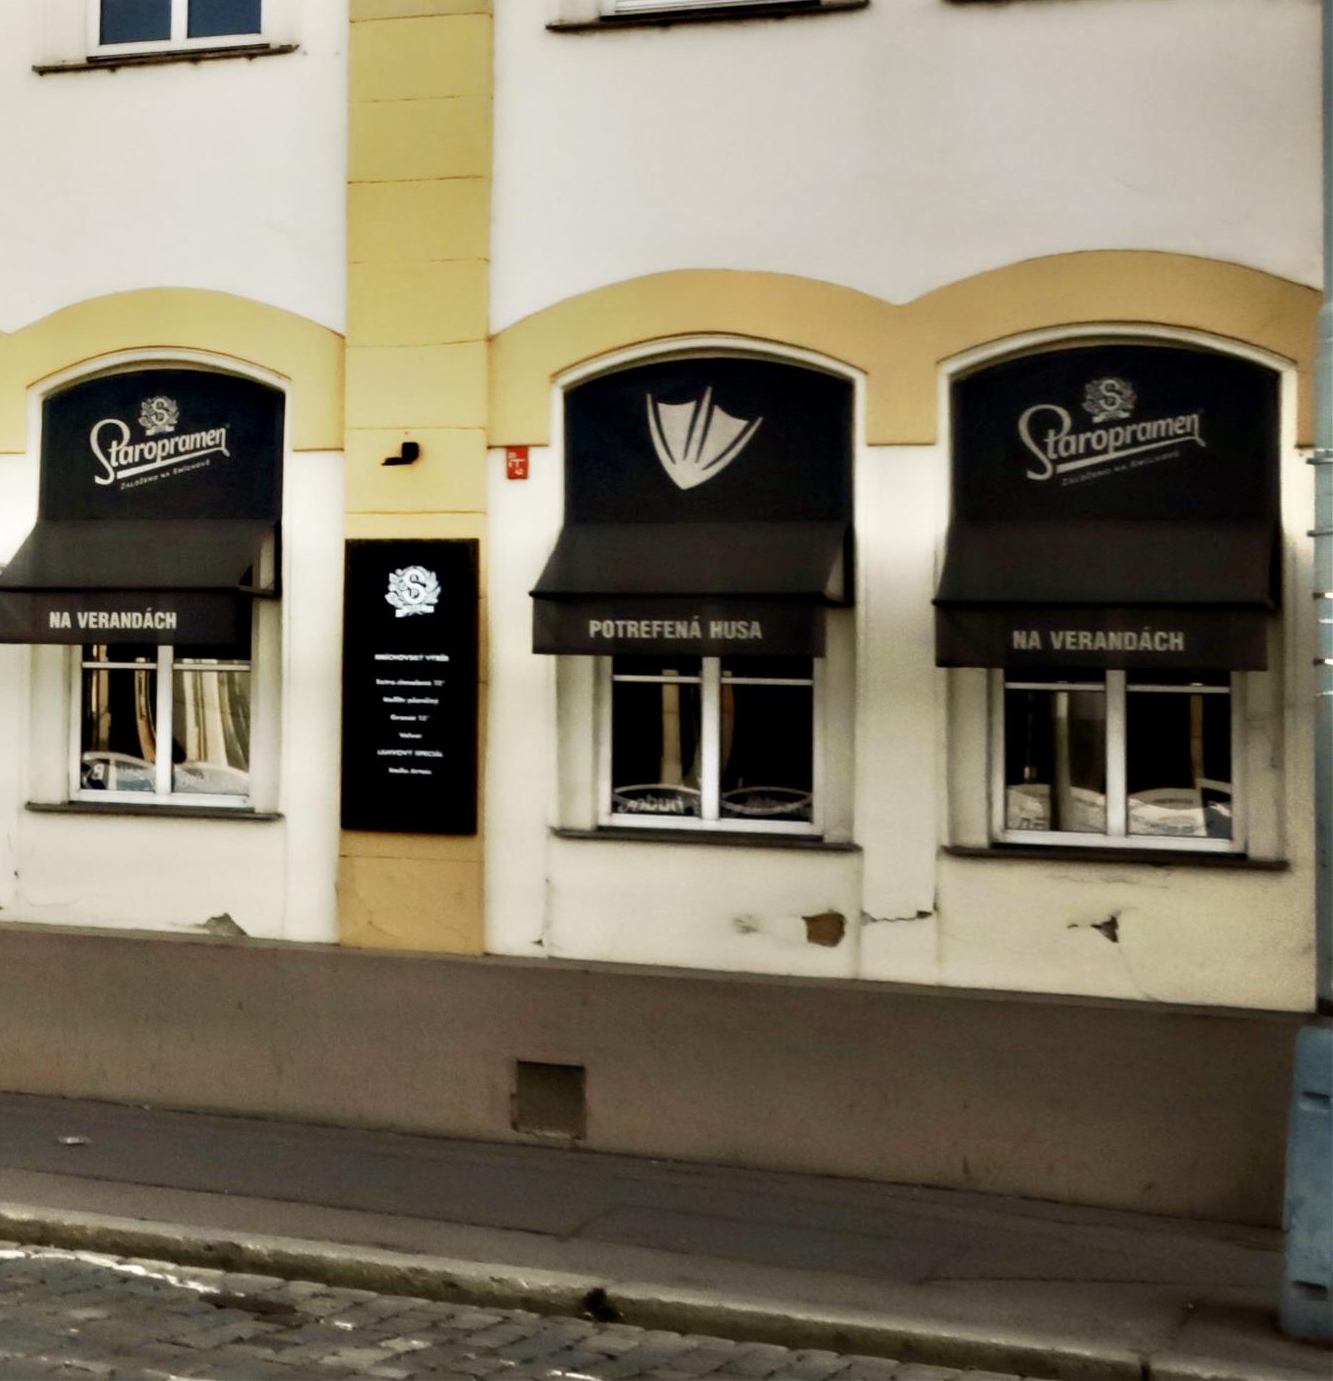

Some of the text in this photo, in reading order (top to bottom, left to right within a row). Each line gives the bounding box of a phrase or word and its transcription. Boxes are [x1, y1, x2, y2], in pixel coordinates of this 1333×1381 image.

[89, 418, 230, 485] Staropramen
[1018, 404, 1206, 481] Staropramen
[49, 607, 178, 630] NA VERANDÁCH
[588, 615, 763, 640] POTREFENÁ HUSA
[1012, 625, 1185, 651] NA VERANDÁCH
